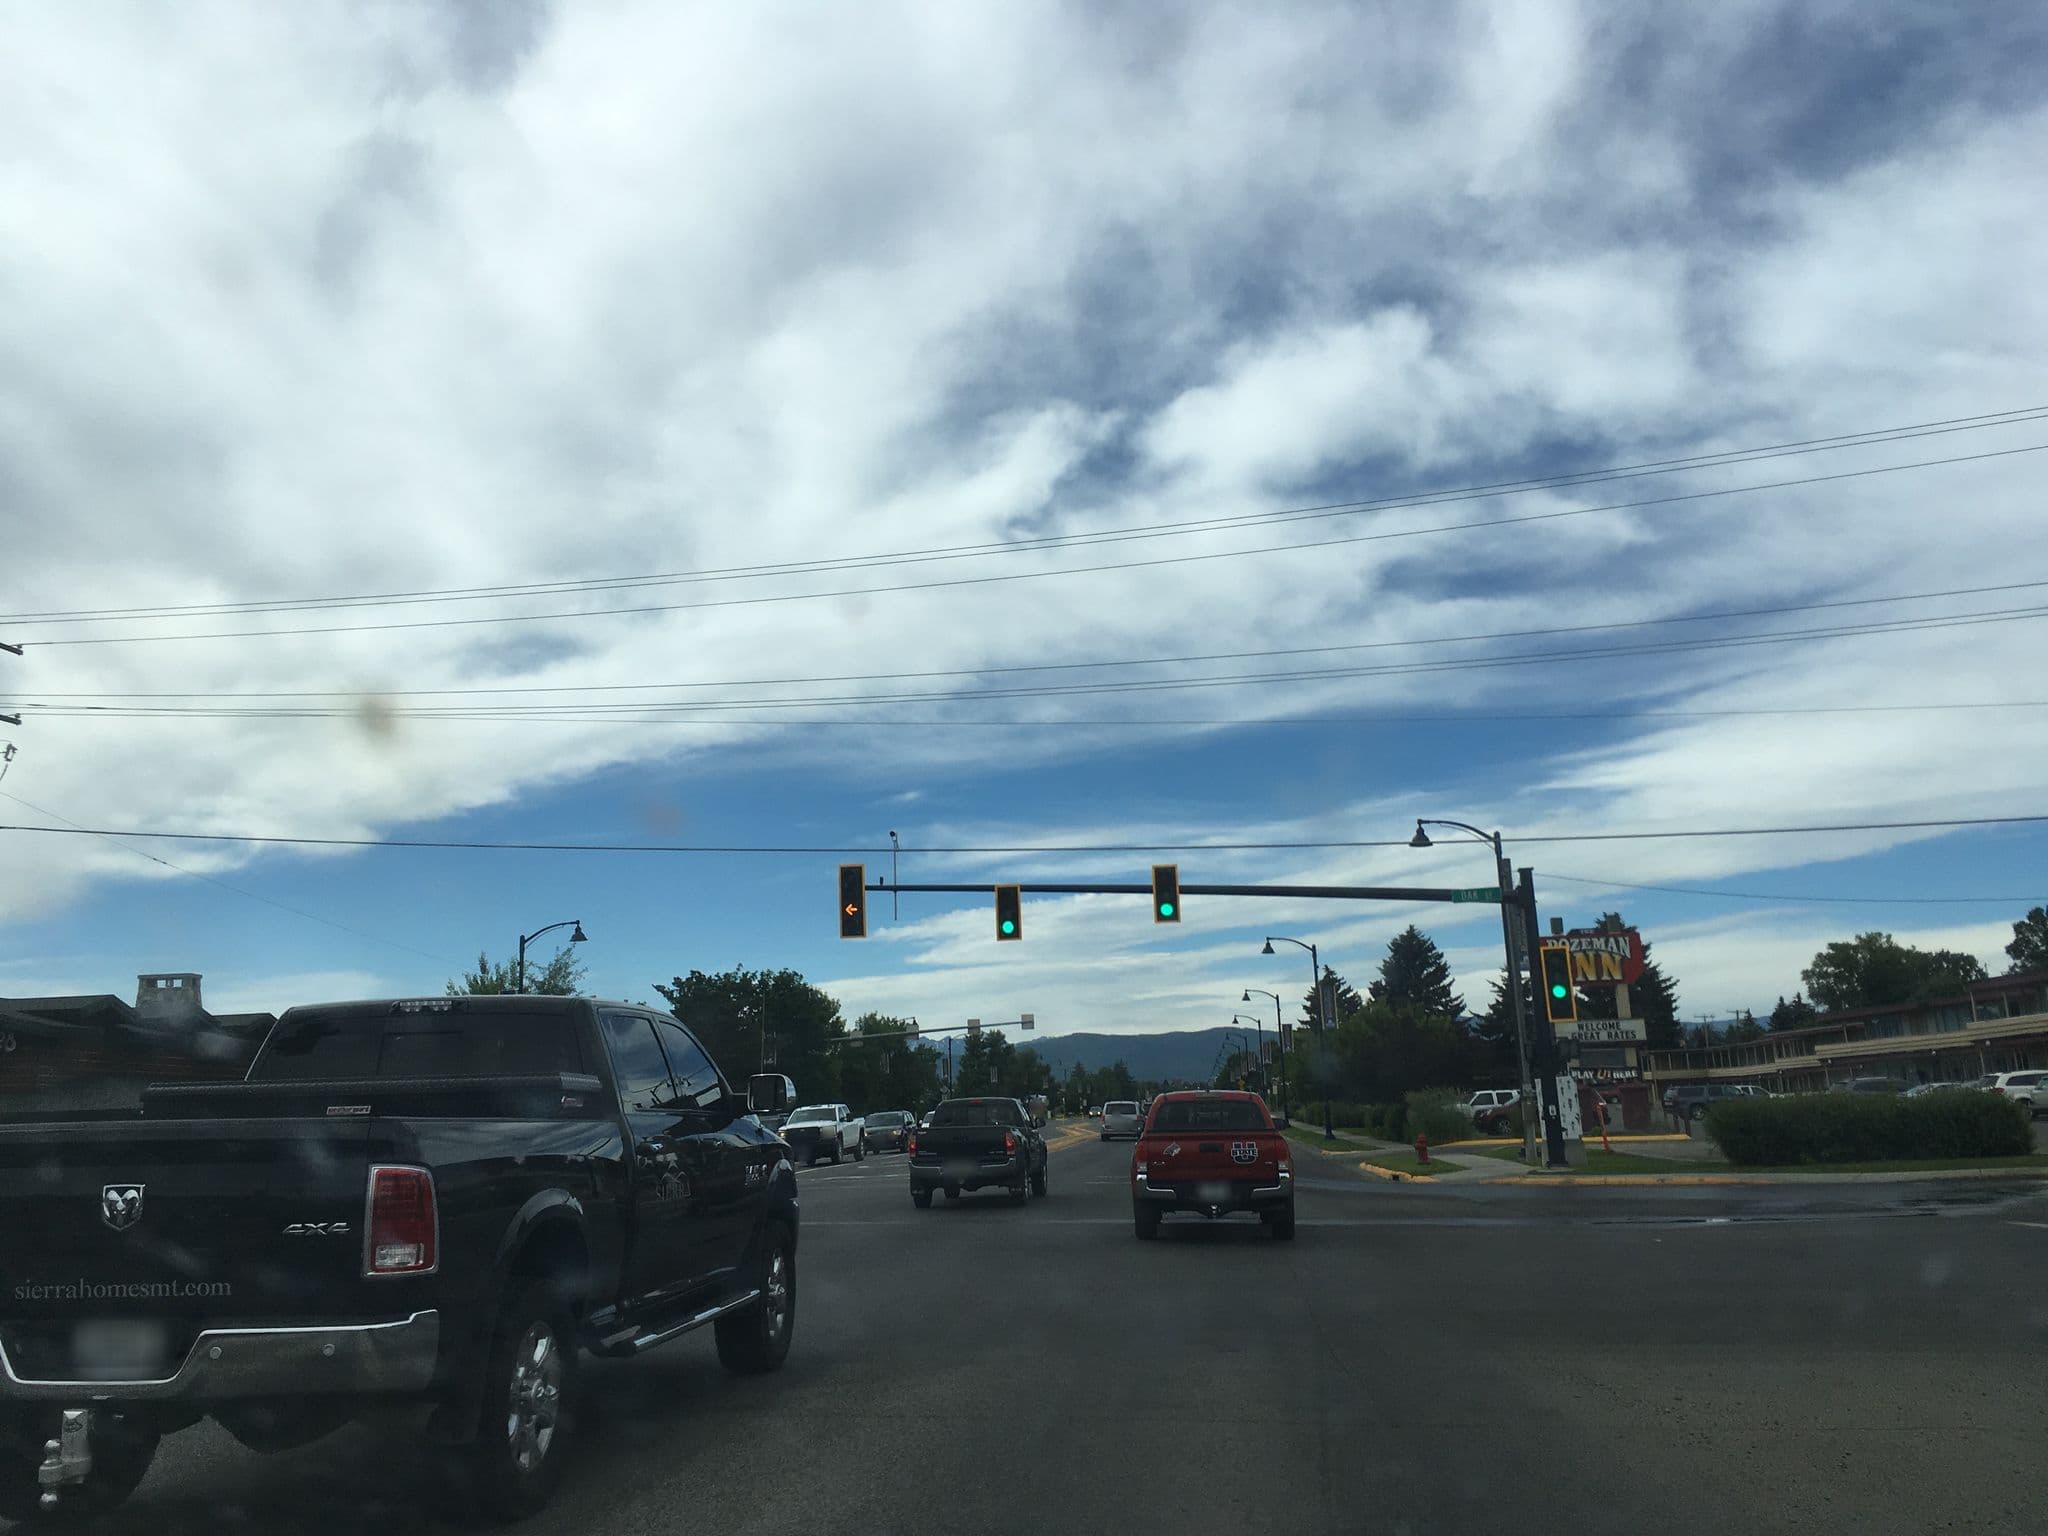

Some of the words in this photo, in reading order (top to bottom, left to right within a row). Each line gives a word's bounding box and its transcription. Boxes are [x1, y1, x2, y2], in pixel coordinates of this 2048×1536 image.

[1577, 1022, 1622, 1032] WELCOME
[1570, 1030, 1601, 1041] GREAT
[1607, 1030, 1637, 1040] RATES
[1571, 1069, 1594, 1080] PLAY
[14, 1278, 233, 1301] sierrahomesmt.com
